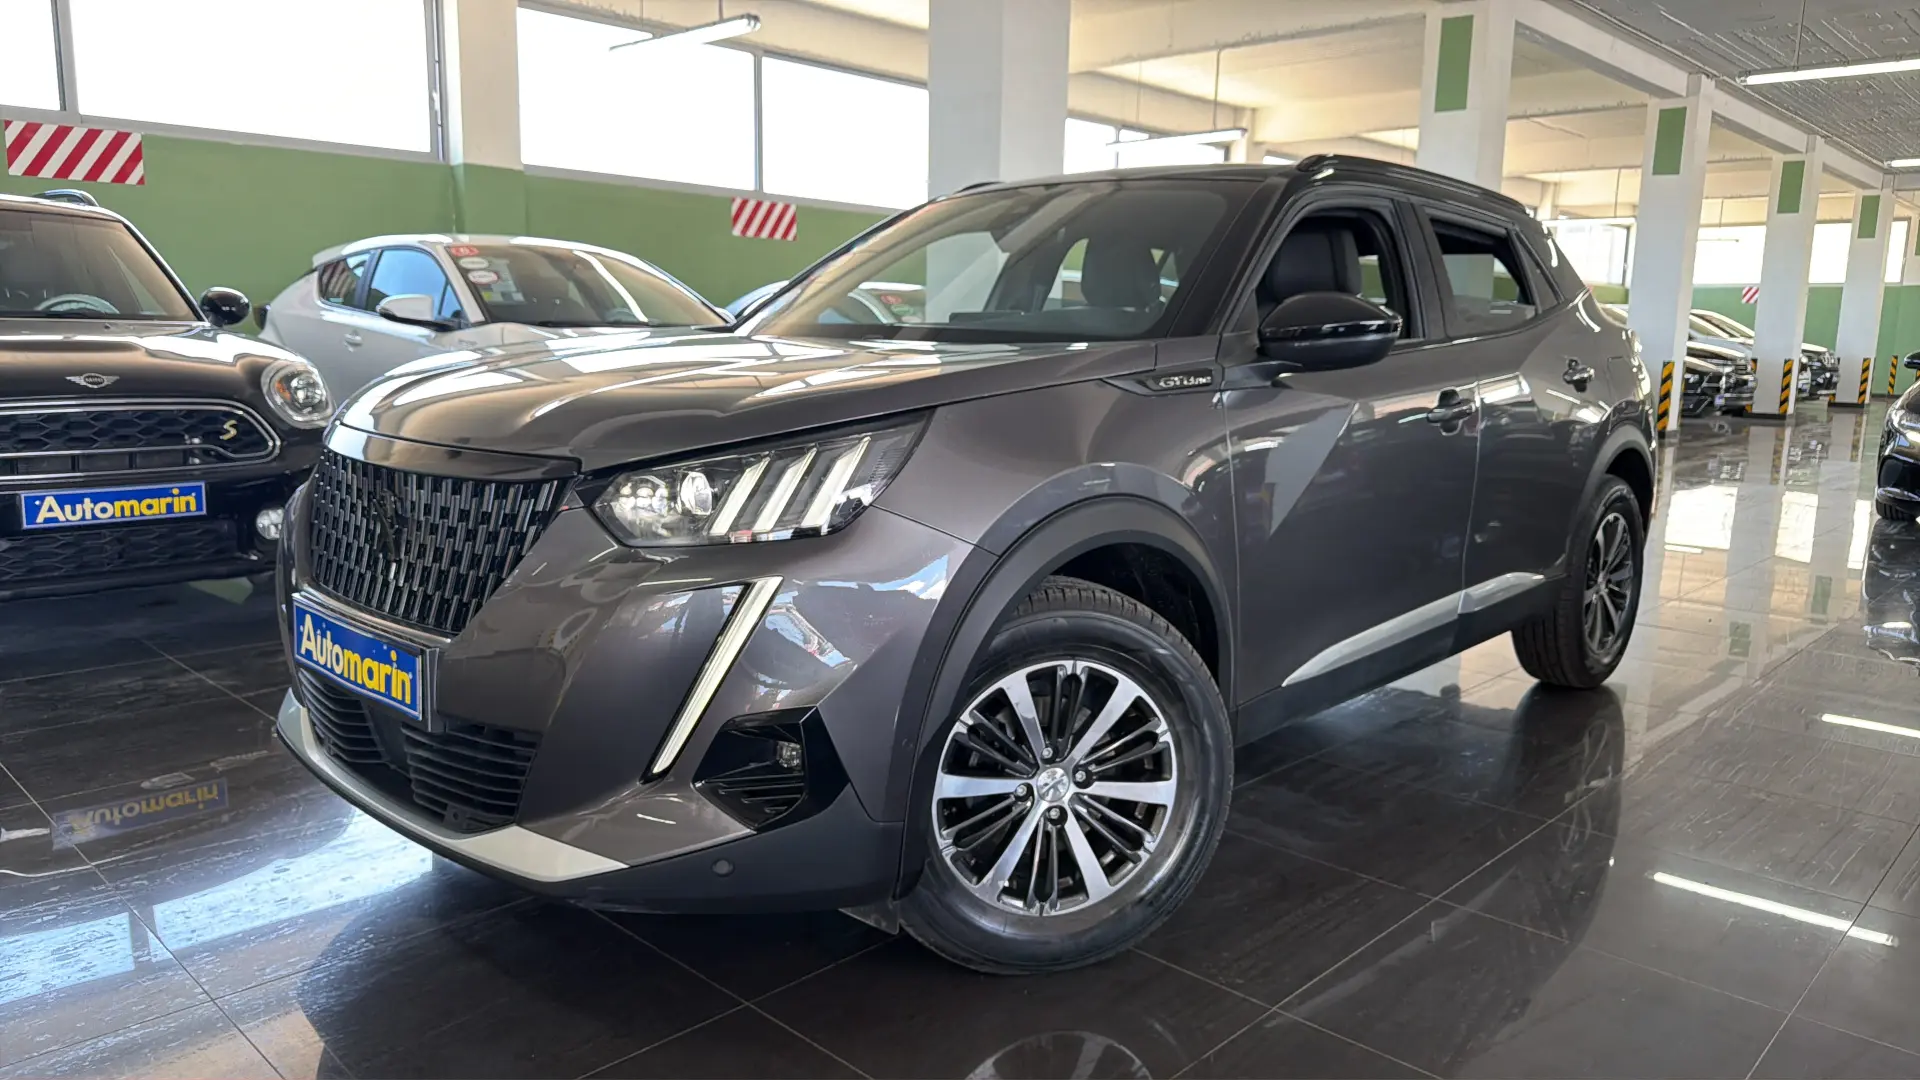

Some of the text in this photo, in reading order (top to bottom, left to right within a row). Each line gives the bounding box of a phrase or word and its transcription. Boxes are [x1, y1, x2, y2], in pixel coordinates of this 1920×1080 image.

[219, 419, 238, 441] S
[35, 487, 197, 524] Automarin
[300, 613, 412, 705] Automarin
